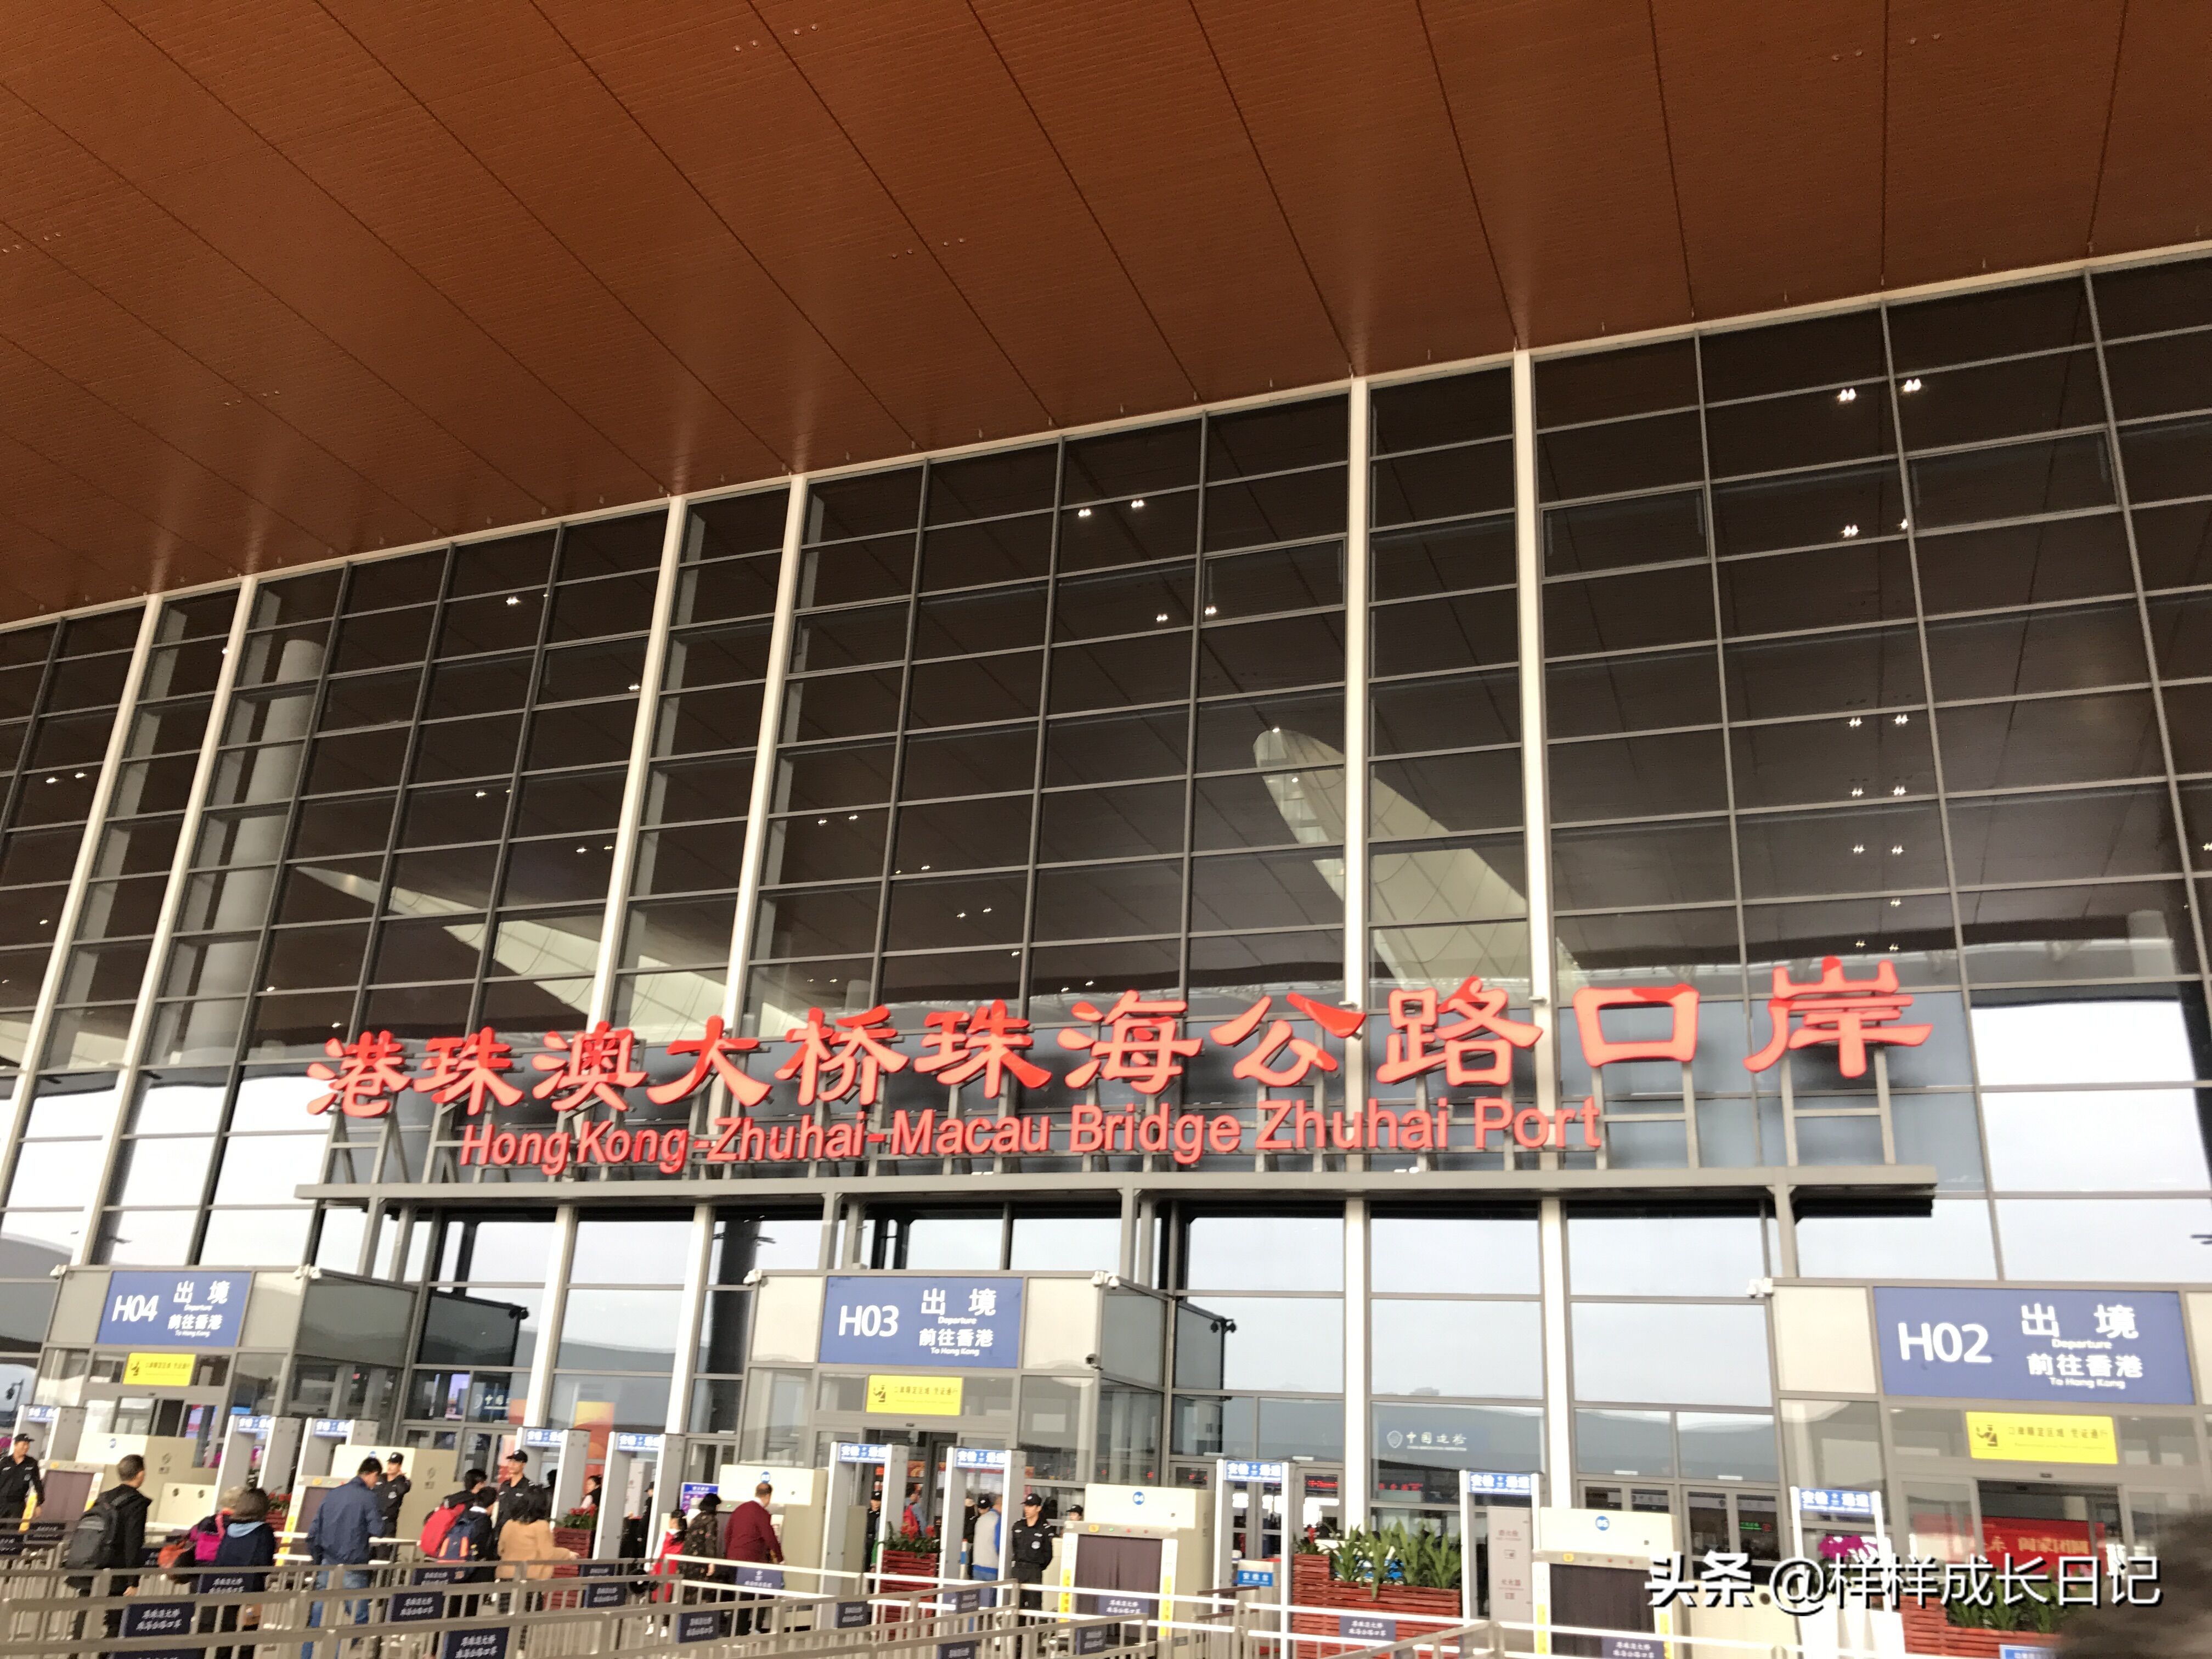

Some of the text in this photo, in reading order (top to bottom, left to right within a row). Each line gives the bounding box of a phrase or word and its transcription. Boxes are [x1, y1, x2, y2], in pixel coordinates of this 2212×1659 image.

[306, 956, 1933, 1118] 港珠澳大桥珠海公路口岸
[460, 1122, 567, 1176] Hong
[1070, 1101, 1242, 1164] Bridge
[1256, 1098, 1448, 1150] Zhuhai
[1474, 1095, 1602, 1149] Port
[111, 1295, 160, 1322] H04
[921, 1288, 996, 1316] 出境
[839, 1305, 899, 1337] H03
[2021, 1303, 2139, 1339] 出境
[919, 1328, 994, 1347] 前往香港
[1898, 1322, 1993, 1363] H02
[2026, 1353, 2143, 1378] 前往香港
